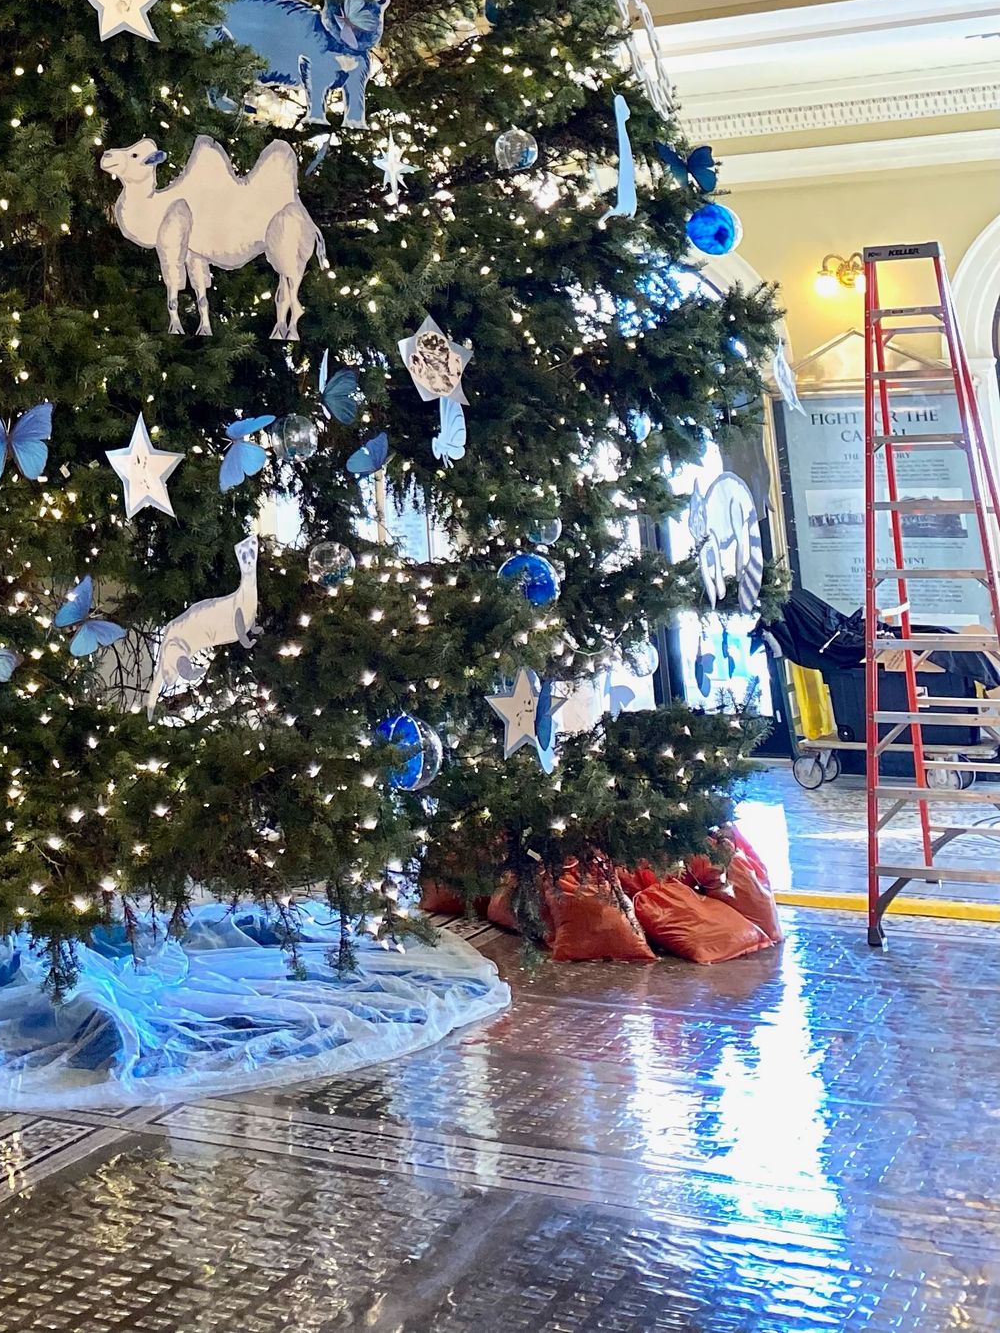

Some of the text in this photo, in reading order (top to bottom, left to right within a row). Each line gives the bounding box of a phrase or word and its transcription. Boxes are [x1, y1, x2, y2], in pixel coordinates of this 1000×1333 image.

[888, 248, 920, 257] KELLER
[811, 412, 859, 426] FIGHT
[904, 410, 939, 423] THE
